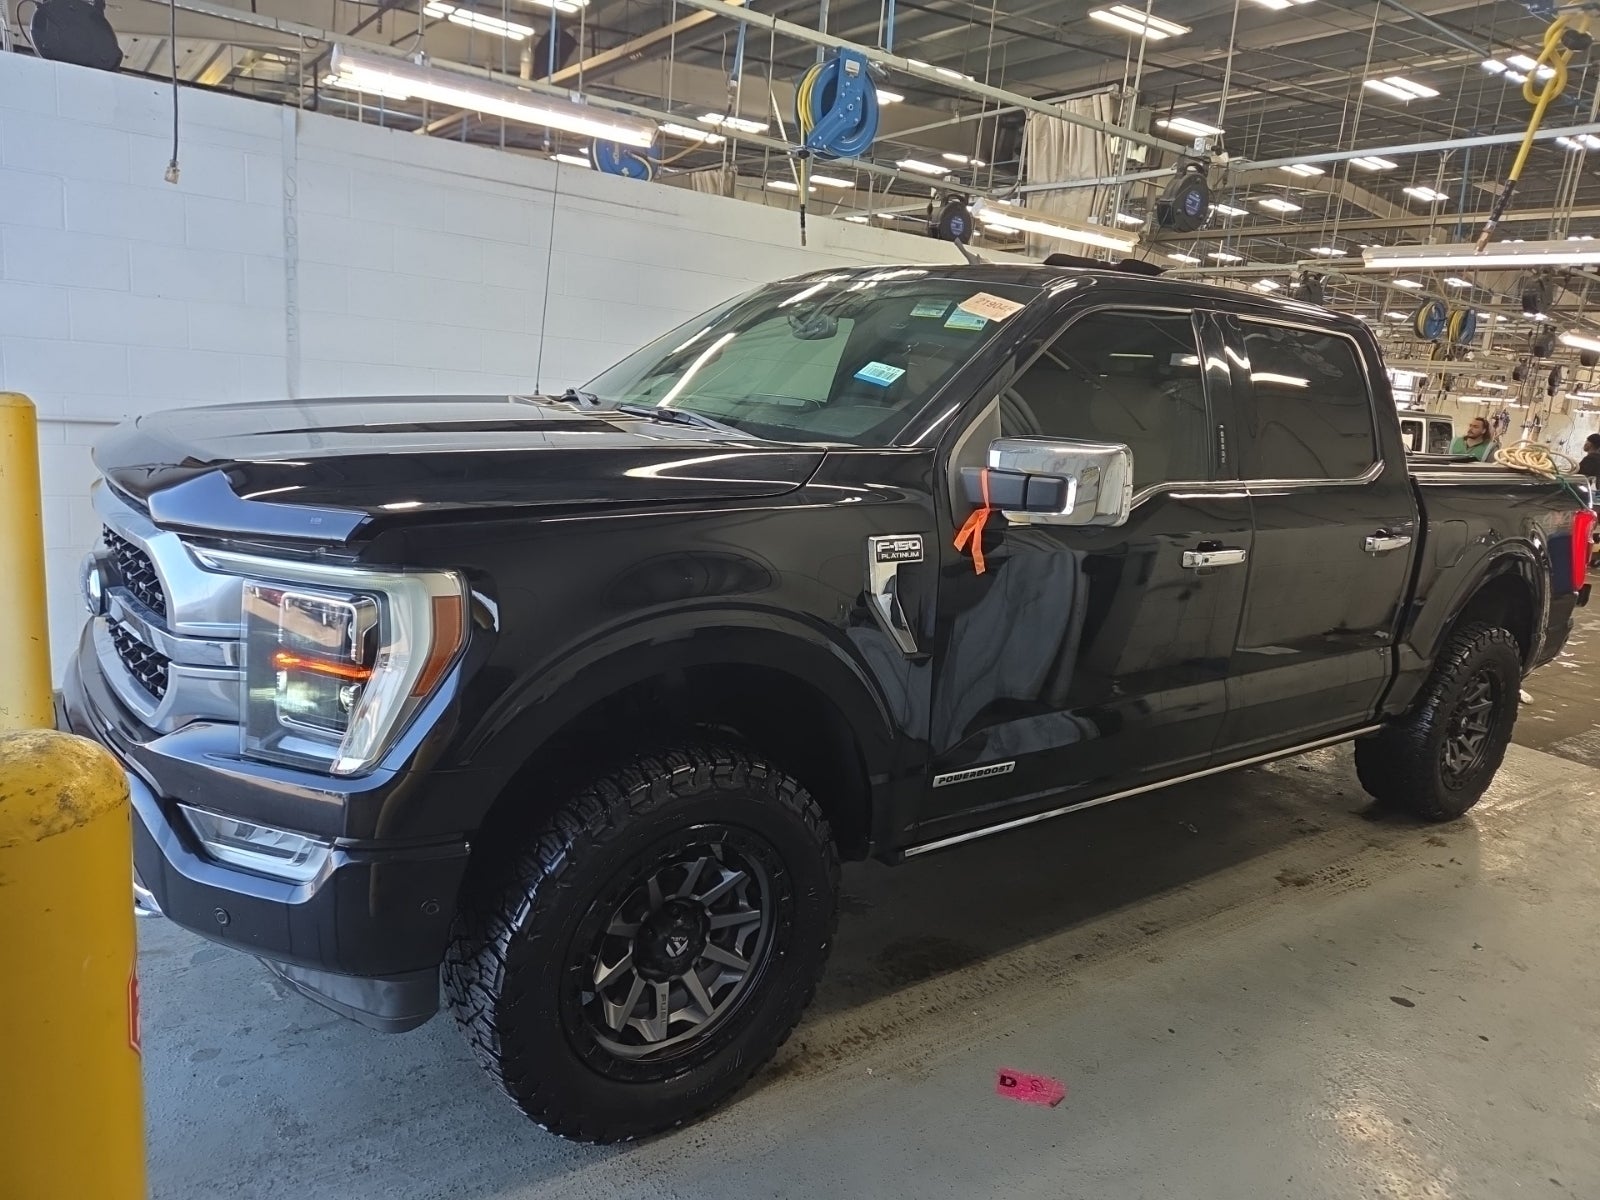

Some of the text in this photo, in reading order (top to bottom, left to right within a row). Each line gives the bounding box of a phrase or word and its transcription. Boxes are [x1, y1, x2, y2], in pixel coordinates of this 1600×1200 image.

[877, 540, 920, 552] F-150
[881, 551, 919, 559] PLATINUM
[938, 764, 1013, 784] POWERBOOST
